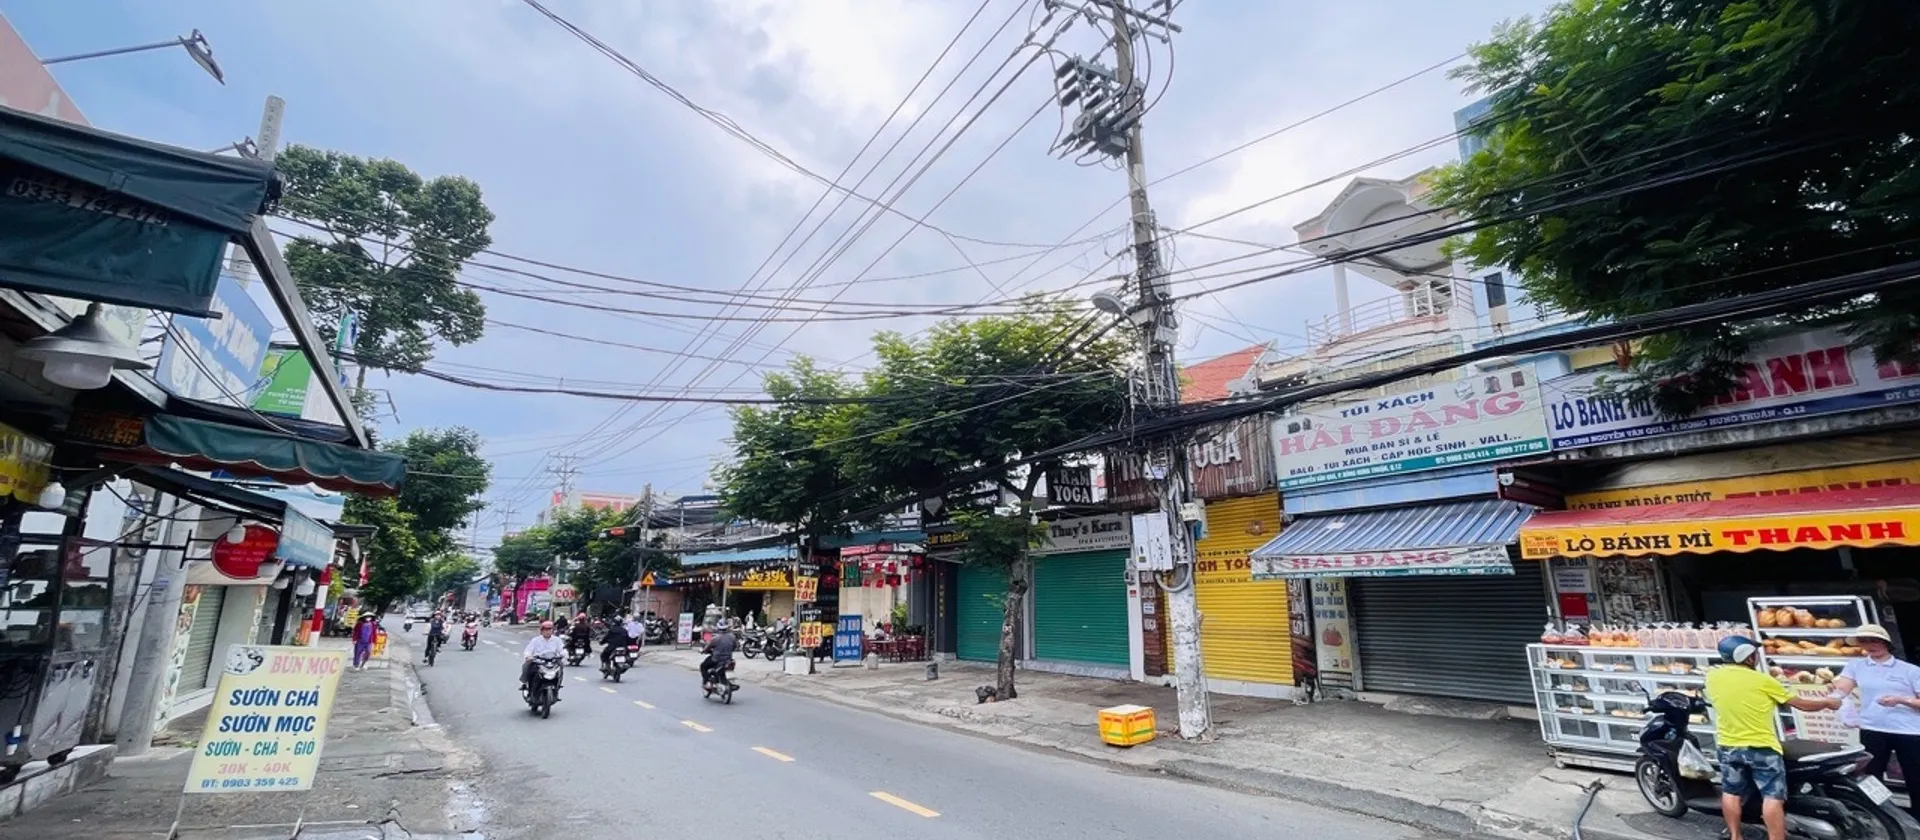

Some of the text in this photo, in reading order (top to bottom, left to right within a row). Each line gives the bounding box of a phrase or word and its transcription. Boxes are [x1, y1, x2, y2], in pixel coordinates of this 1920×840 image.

[1435, 440, 1467, 453] SINH
[1053, 486, 1091, 503] YOGA
[1091, 520, 1122, 533] Kara
[1565, 534, 1596, 552] LÒ
[1601, 533, 1672, 551] BÁNH
[1677, 529, 1713, 548] MÌ
[1722, 522, 1906, 546] THANH
[285, 685, 321, 706] CHẢ
[275, 715, 317, 735] MỌC
[217, 763, 247, 774] 30K
[263, 762, 292, 774] 40K
[254, 777, 275, 787] 359
[278, 776, 299, 786] 425
